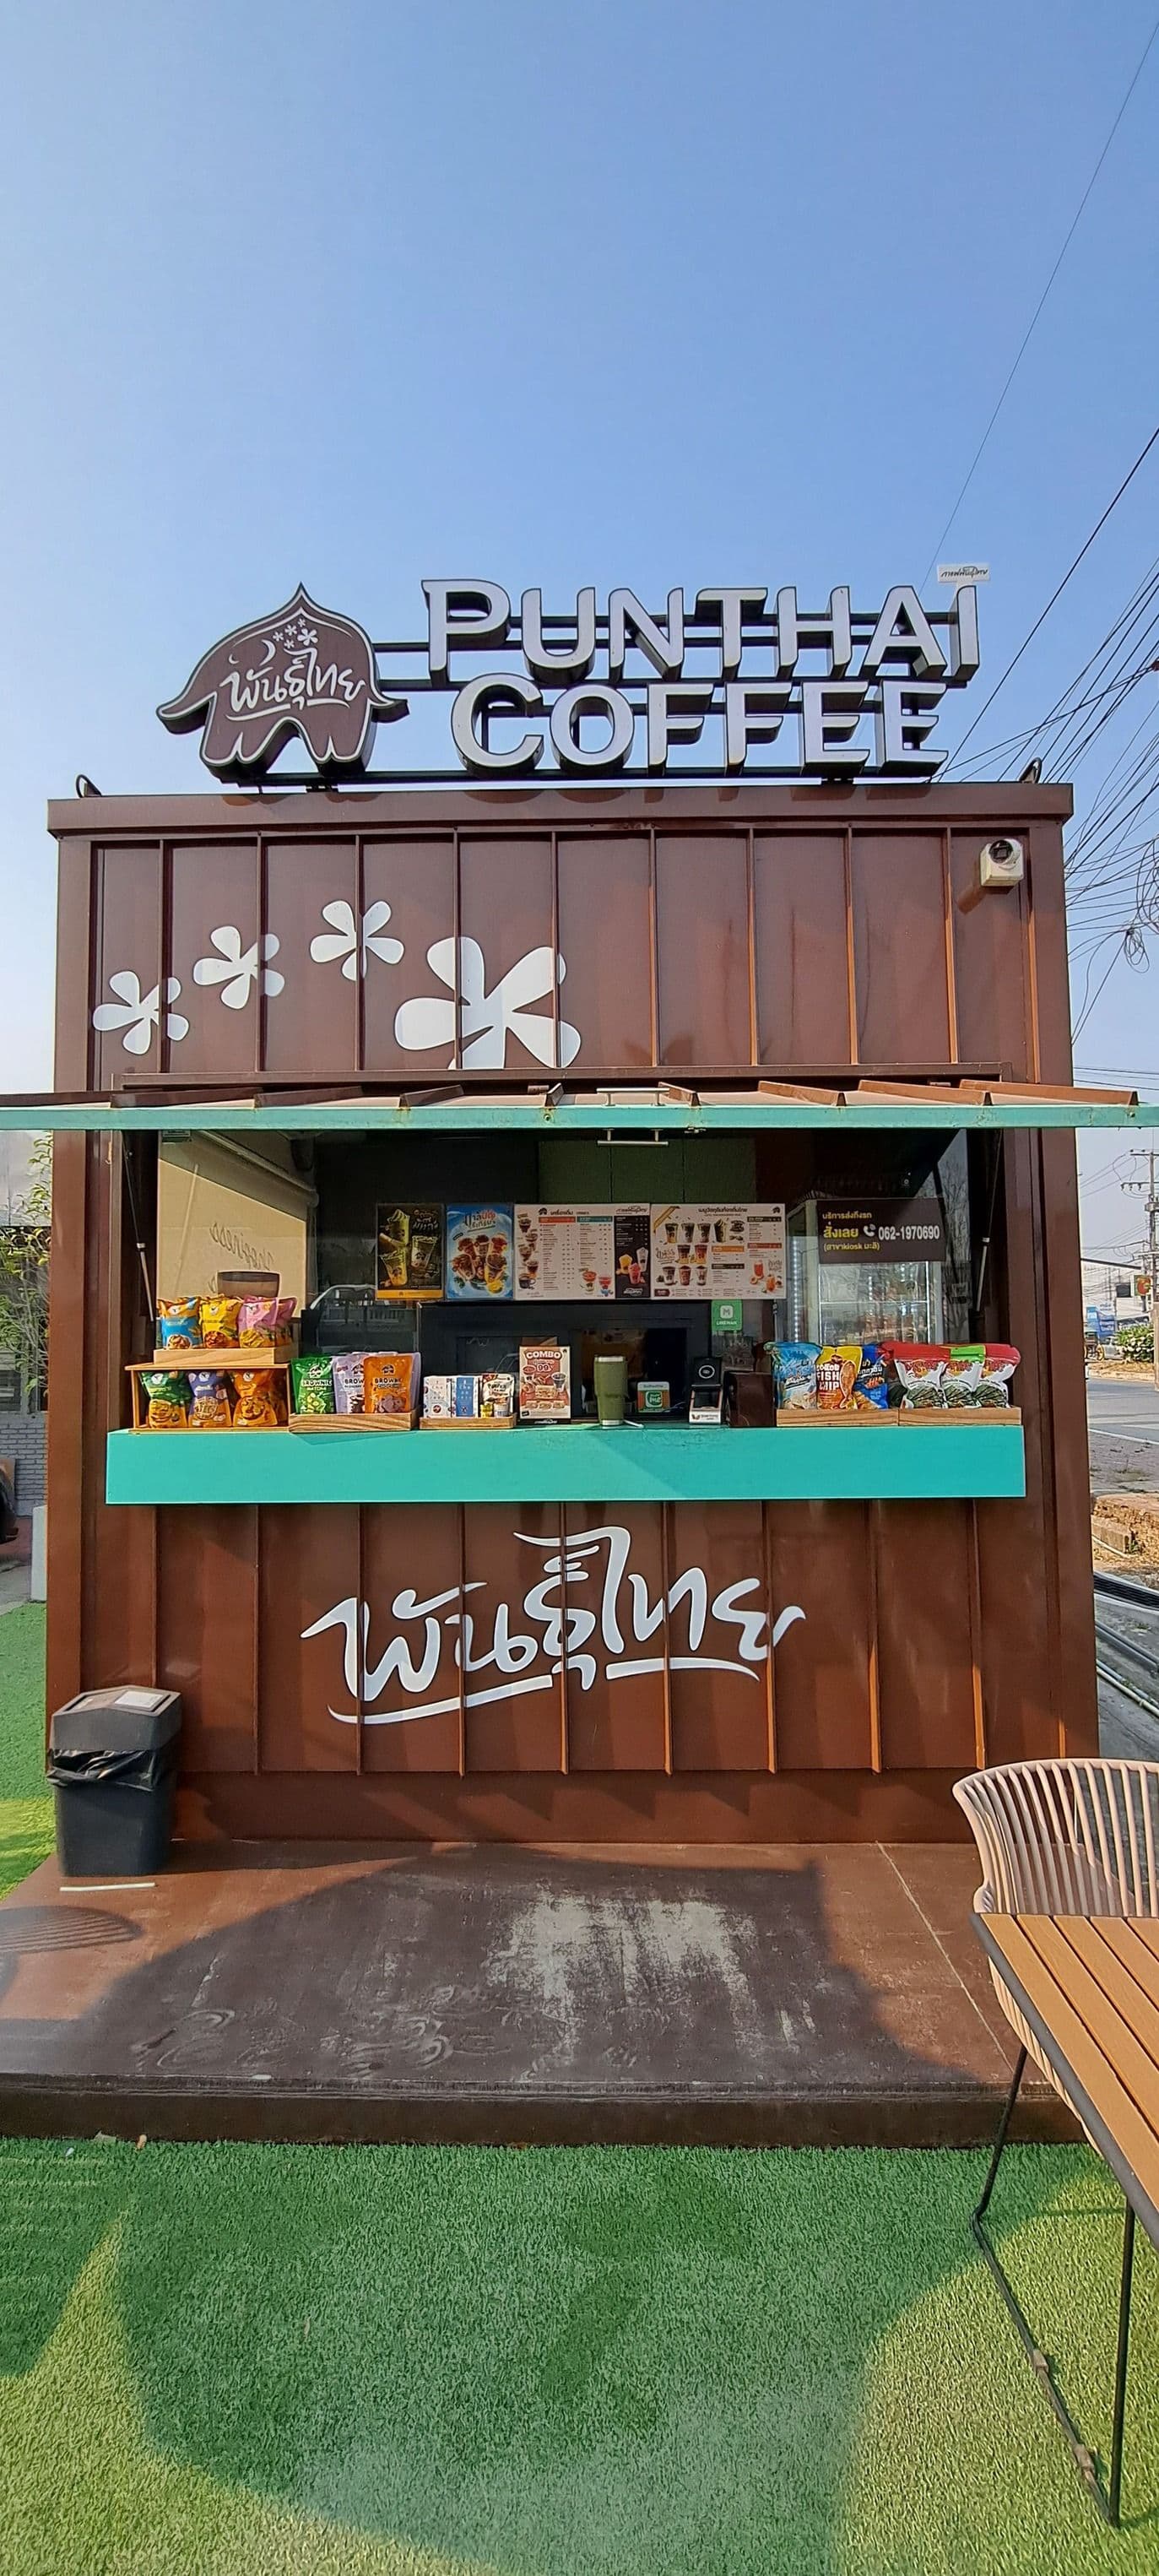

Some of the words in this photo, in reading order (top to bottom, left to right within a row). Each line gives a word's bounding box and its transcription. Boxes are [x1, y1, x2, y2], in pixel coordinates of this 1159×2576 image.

[421, 579, 981, 681] PUNTHAI
[219, 648, 367, 721] พันธุ์ไทย
[451, 673, 949, 777] COFFEE
[823, 1221, 859, 1239] สั่งเลย
[878, 1225, 940, 1240] 062-1970690
[525, 1351, 562, 1359] COMBO
[816, 1371, 840, 1380] FISH
[301, 1526, 806, 1724] พันธุ์ไทย
